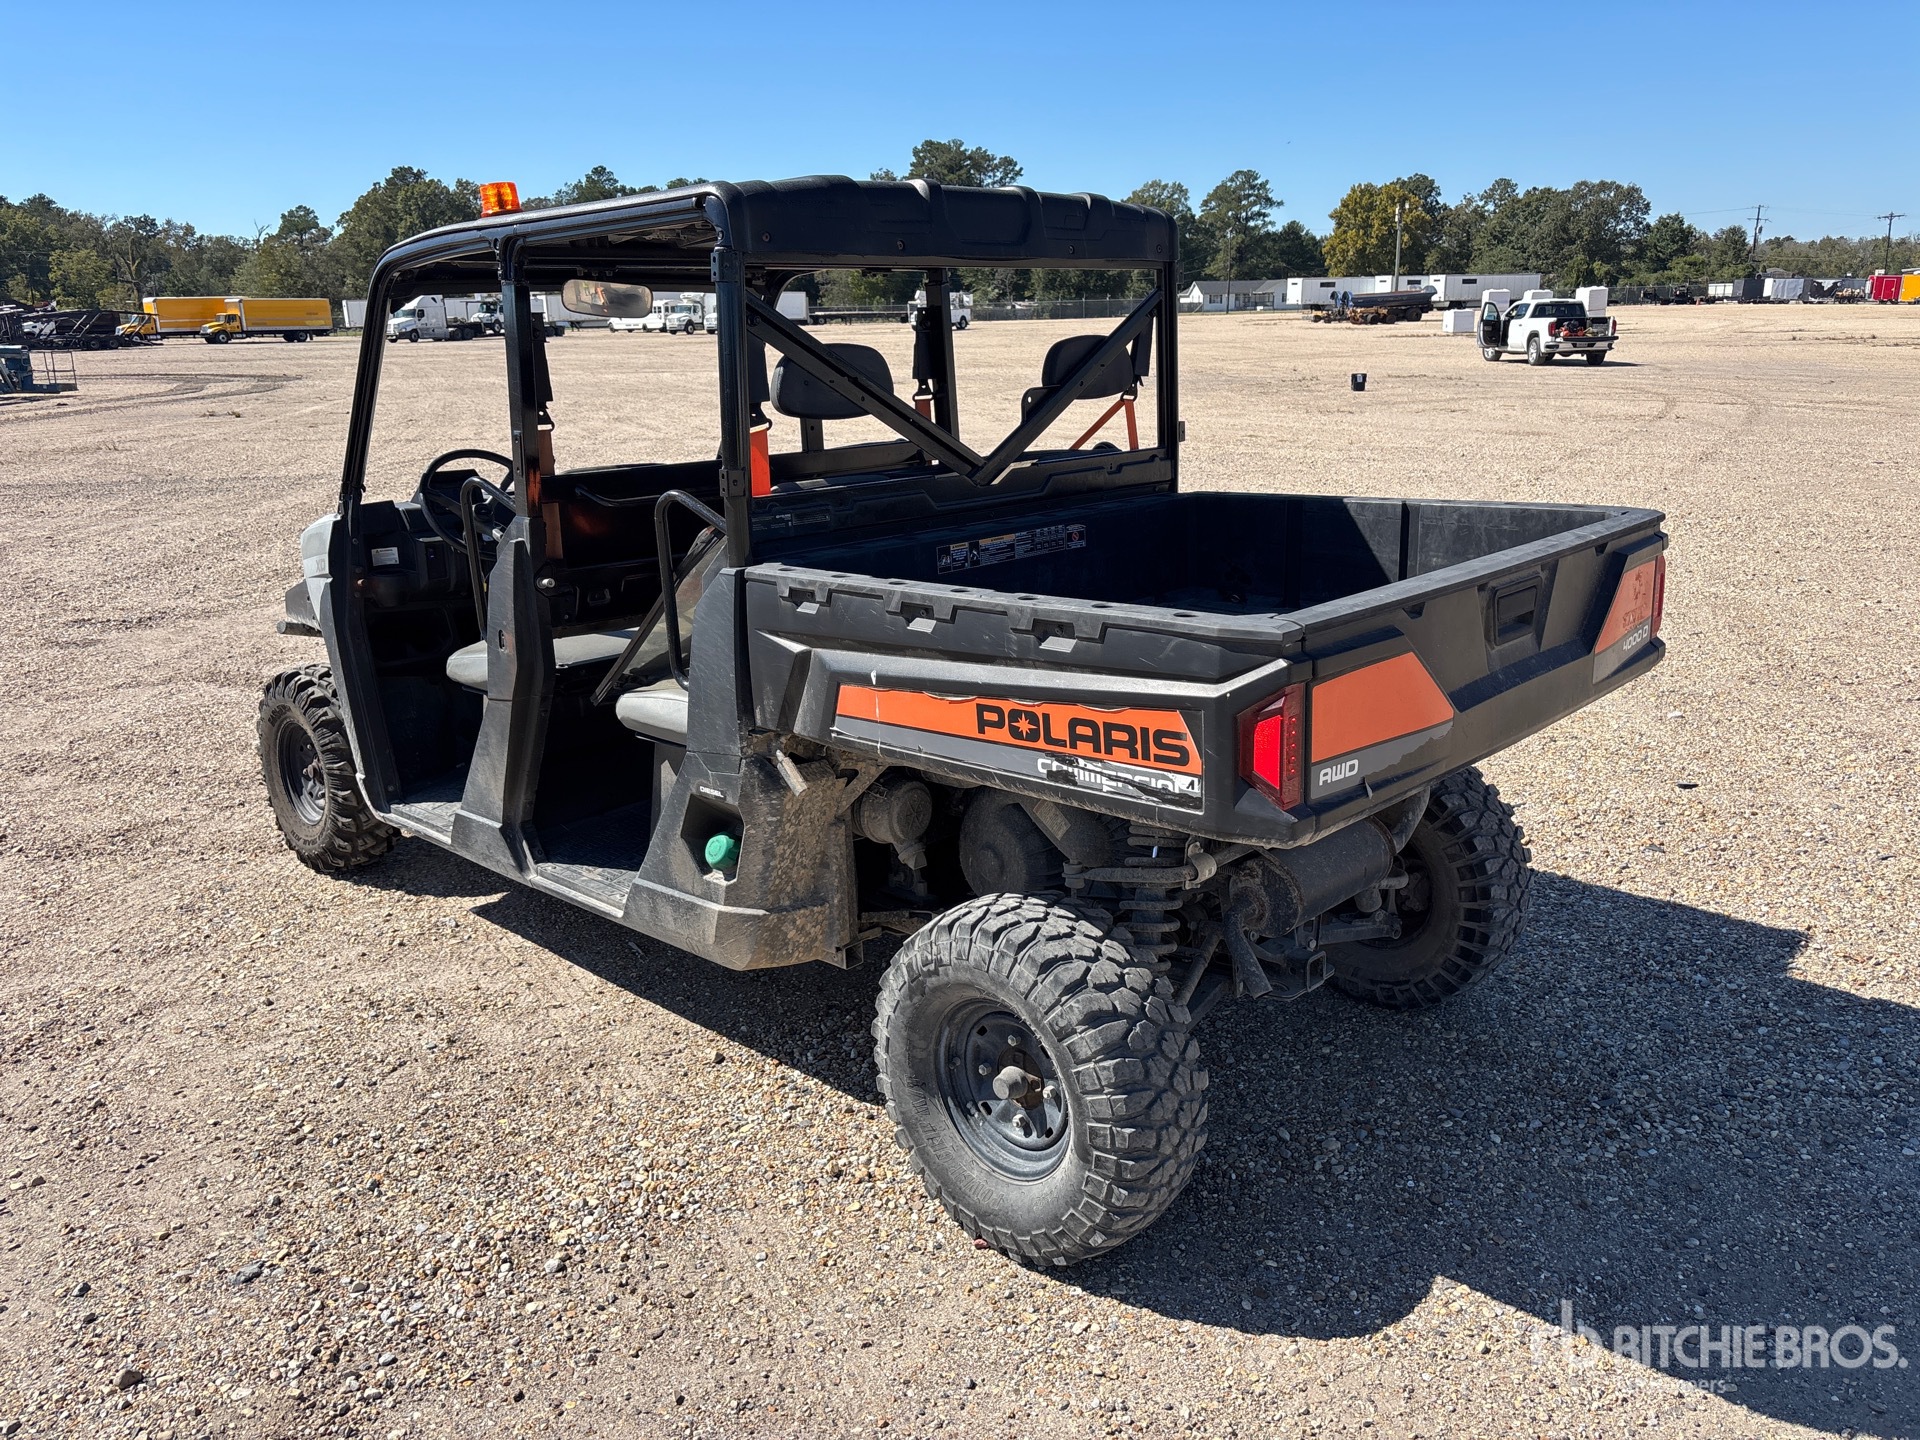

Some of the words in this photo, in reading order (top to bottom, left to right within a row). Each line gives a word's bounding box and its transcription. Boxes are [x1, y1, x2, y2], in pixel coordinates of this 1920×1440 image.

[1623, 630, 1642, 650] 4000
[976, 703, 1190, 767] POLARIS
[1319, 759, 1359, 786] AWD
